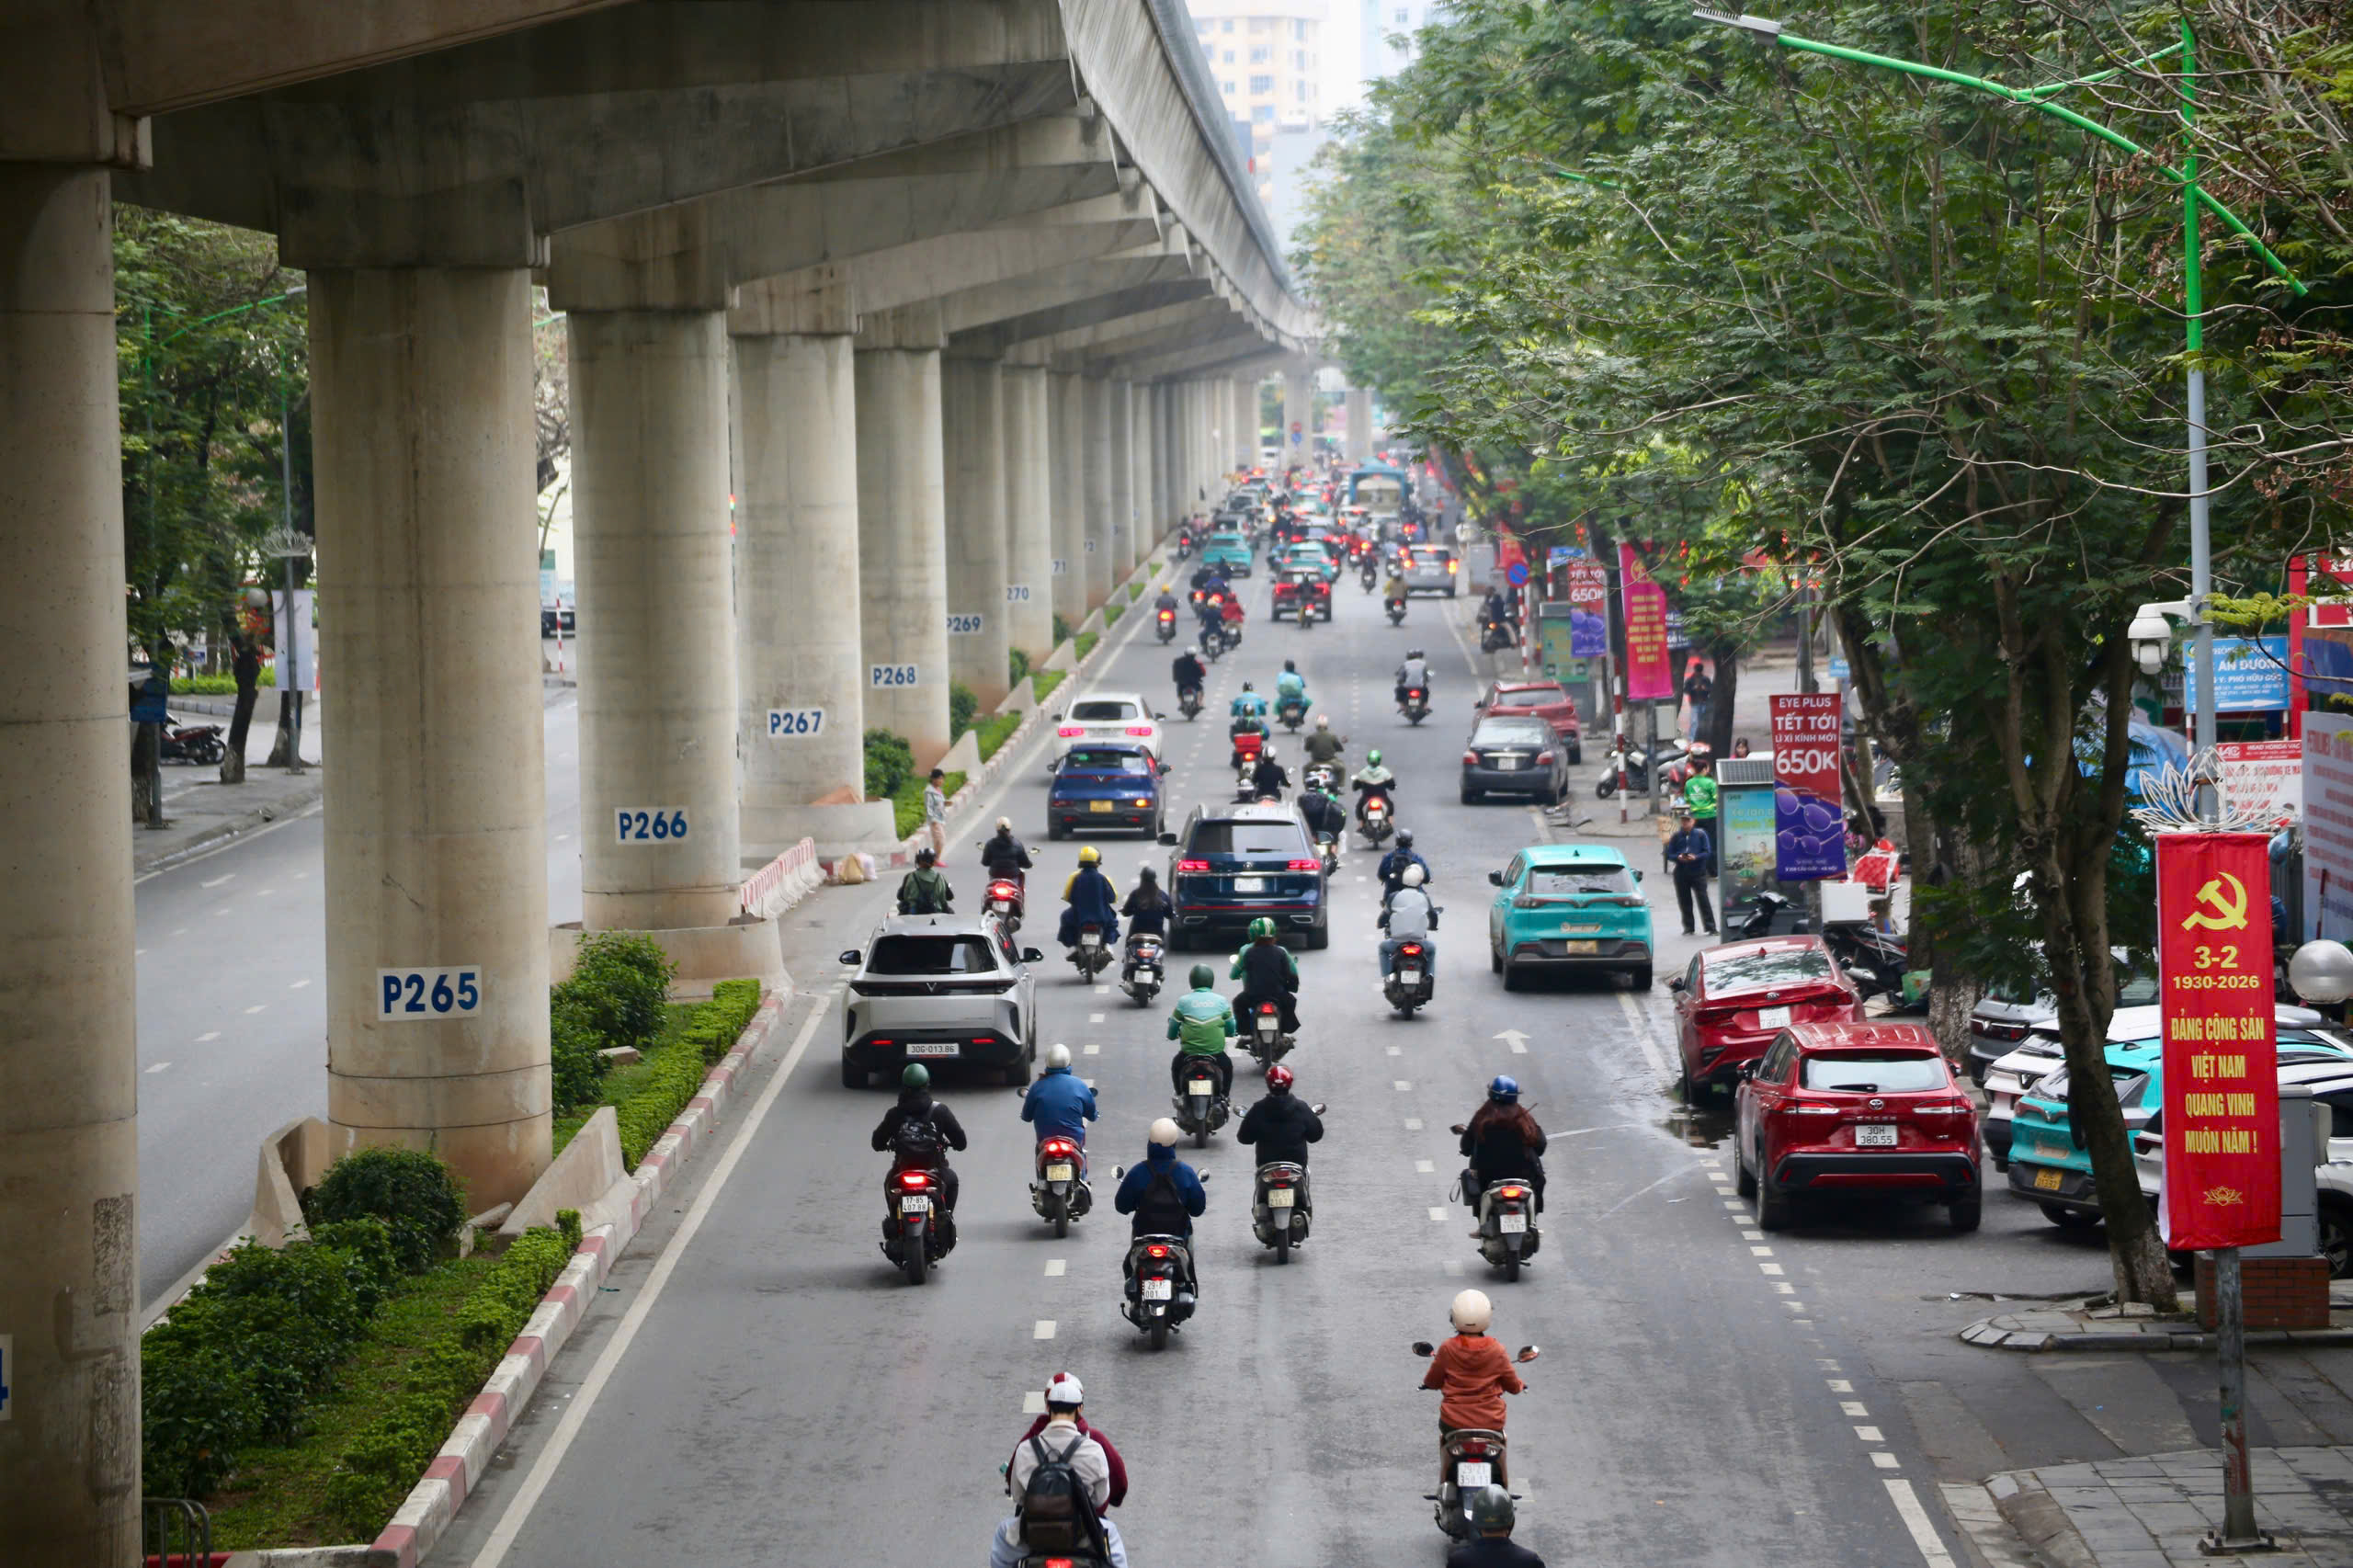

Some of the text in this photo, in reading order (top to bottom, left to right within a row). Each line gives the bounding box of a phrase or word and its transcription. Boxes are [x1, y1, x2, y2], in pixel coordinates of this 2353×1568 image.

[873, 666, 915, 685] P268
[1779, 698, 1832, 708] EYE PLUS
[770, 711, 822, 734] P267
[1775, 712, 1836, 731] TẾT TỚI
[1794, 733, 1816, 743] KÍNH
[1818, 733, 1836, 742] MỚI
[1776, 749, 1836, 774] 650K
[619, 811, 688, 840] P266
[2194, 946, 2238, 969] 3-2
[383, 972, 478, 1013] P265
[2173, 975, 2259, 989] 1930-2026
[2171, 1007, 2265, 1045] ĐẢNG CỘNG SẢN
[911, 1045, 955, 1053] 30G-013.86
[2191, 1051, 2245, 1083] VIỆT NAM
[2185, 1093, 2255, 1118] QUANG VINH
[1860, 1135, 1893, 1144] 380.55
[1867, 1126, 1885, 1135] 30H
[2185, 1126, 2257, 1153] MUÔN NĂM !
